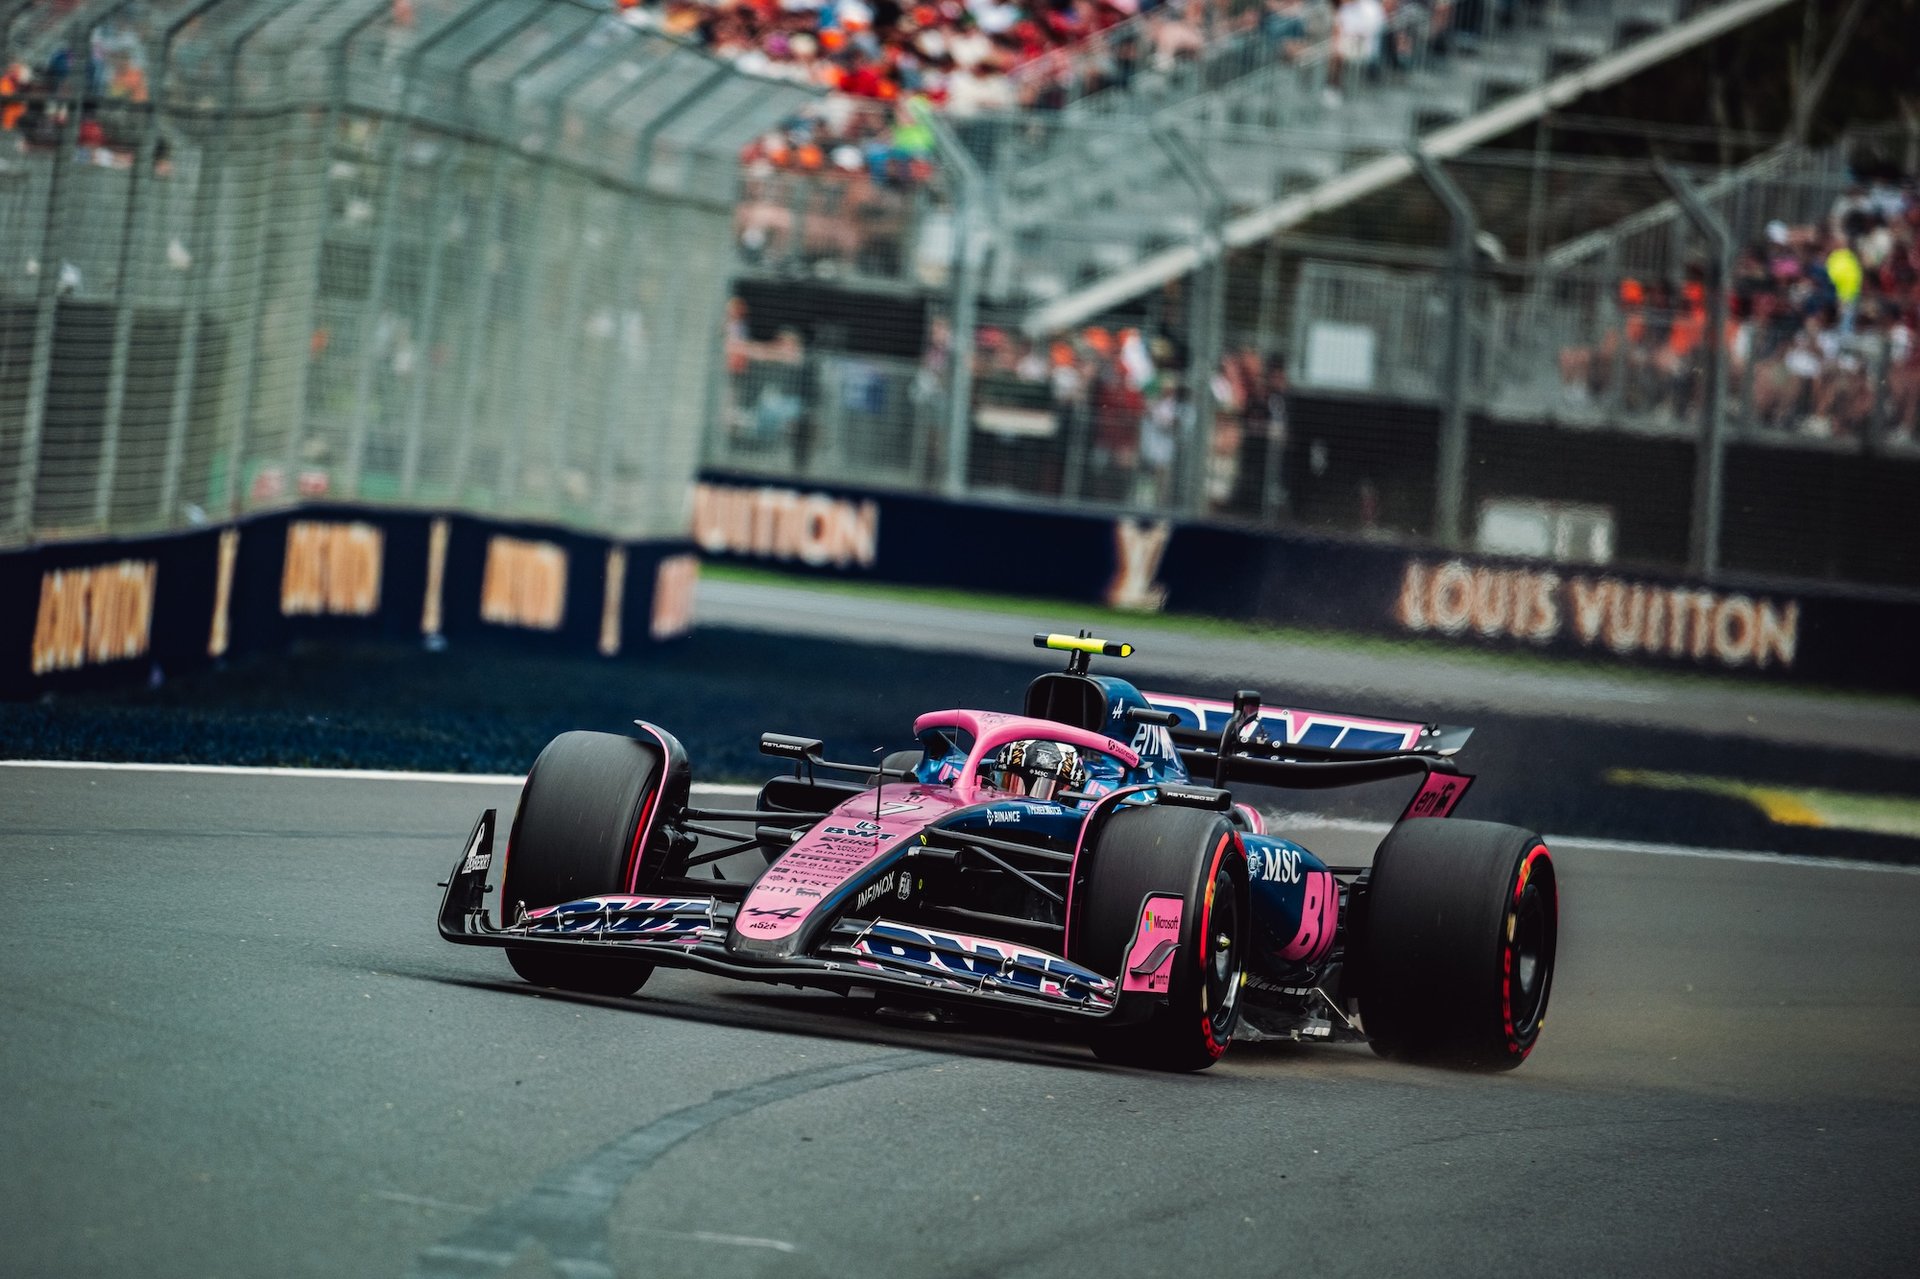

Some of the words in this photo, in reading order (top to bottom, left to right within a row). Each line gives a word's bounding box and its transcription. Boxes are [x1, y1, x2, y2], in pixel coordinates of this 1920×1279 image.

[692, 486, 880, 568] UITTON
[1400, 560, 1561, 644] LOUIS
[1571, 575, 1799, 667] VUITTON
[868, 802, 923, 815] 7
[994, 811, 1020, 823] BINANCE
[823, 826, 897, 840] BWT
[1261, 847, 1302, 884] MSC
[791, 870, 845, 880] Microsoft
[756, 884, 793, 894] eni
[789, 877, 837, 888] MSC
[856, 871, 895, 911] INFINOX
[1153, 915, 1179, 930] Microsoft
